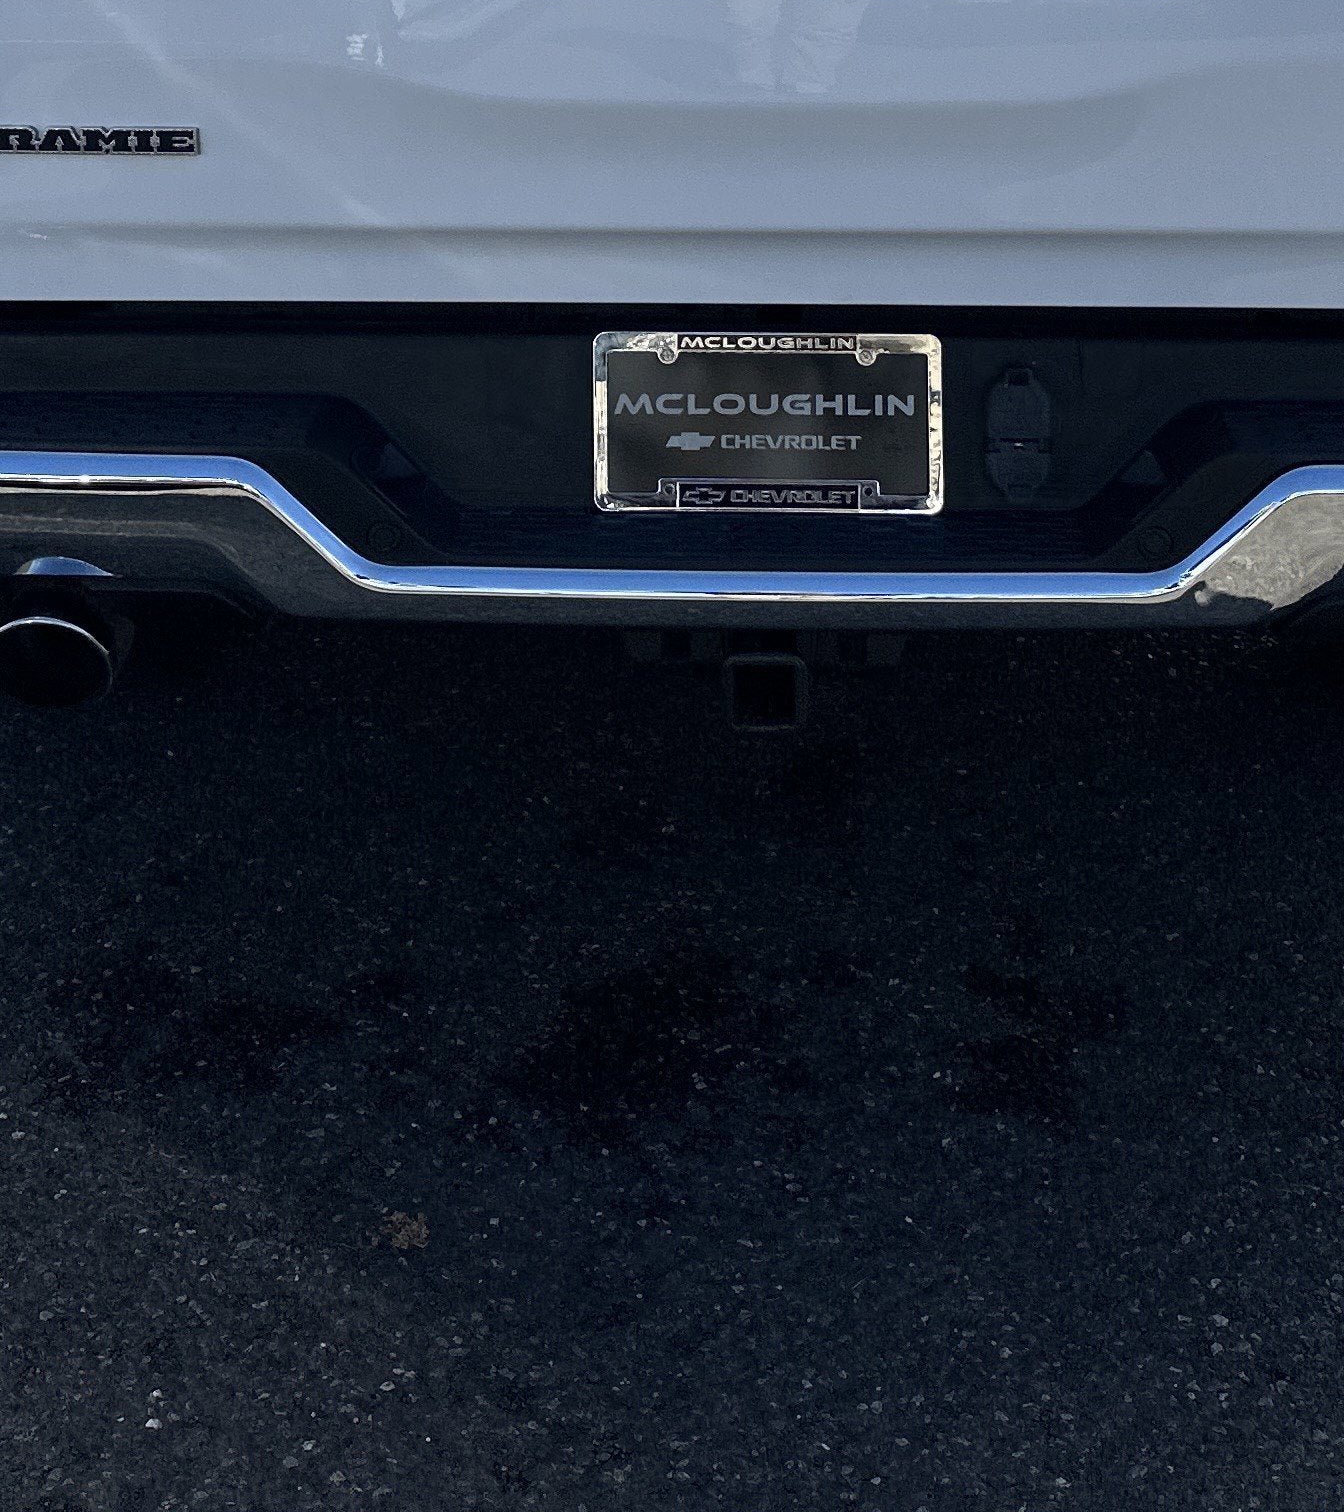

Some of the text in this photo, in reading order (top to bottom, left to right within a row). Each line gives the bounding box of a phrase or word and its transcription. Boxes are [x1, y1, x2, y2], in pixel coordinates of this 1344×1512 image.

[680, 336, 855, 350] MCLOUGHLIN
[613, 392, 916, 417] MCLOUGHLIN
[720, 434, 863, 451] CHEVROLET
[729, 488, 857, 505] CHEVROLET
